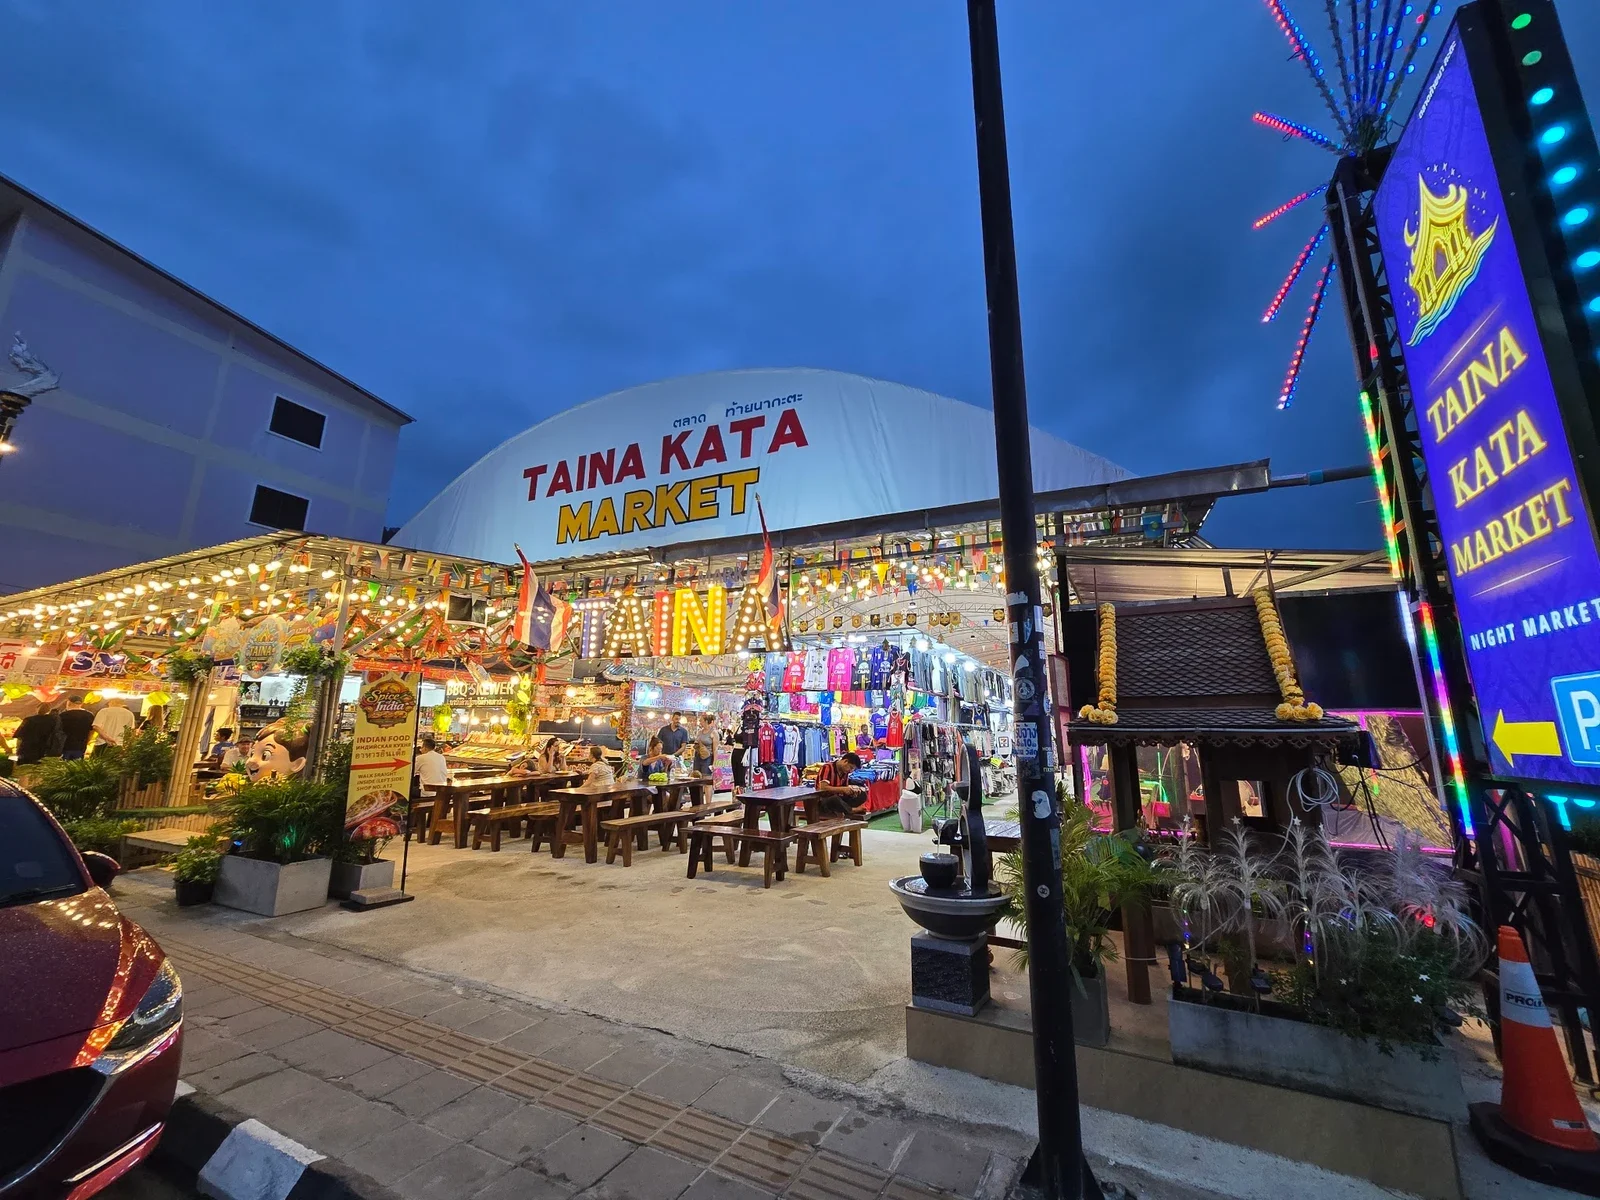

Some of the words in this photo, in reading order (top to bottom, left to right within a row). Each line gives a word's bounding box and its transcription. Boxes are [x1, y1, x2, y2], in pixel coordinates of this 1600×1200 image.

[673, 413, 706, 428] ตลาด
[725, 393, 803, 417] ท้ายนากะตะ
[1426, 326, 1528, 444] TAINA
[523, 442, 646, 502] TAINA
[660, 408, 809, 475] KATA
[1448, 409, 1548, 509] KATA
[556, 466, 760, 545] MARKET
[1451, 477, 1574, 577] MARKET
[573, 584, 788, 658] TAINA
[1470, 622, 1516, 651] NIGHT
[1522, 597, 1600, 638] MARKET
[366, 689, 400, 703] Spice
[374, 700, 405, 712] India
[1570, 690, 1600, 750] P
[388, 734, 411, 742] FOOD
